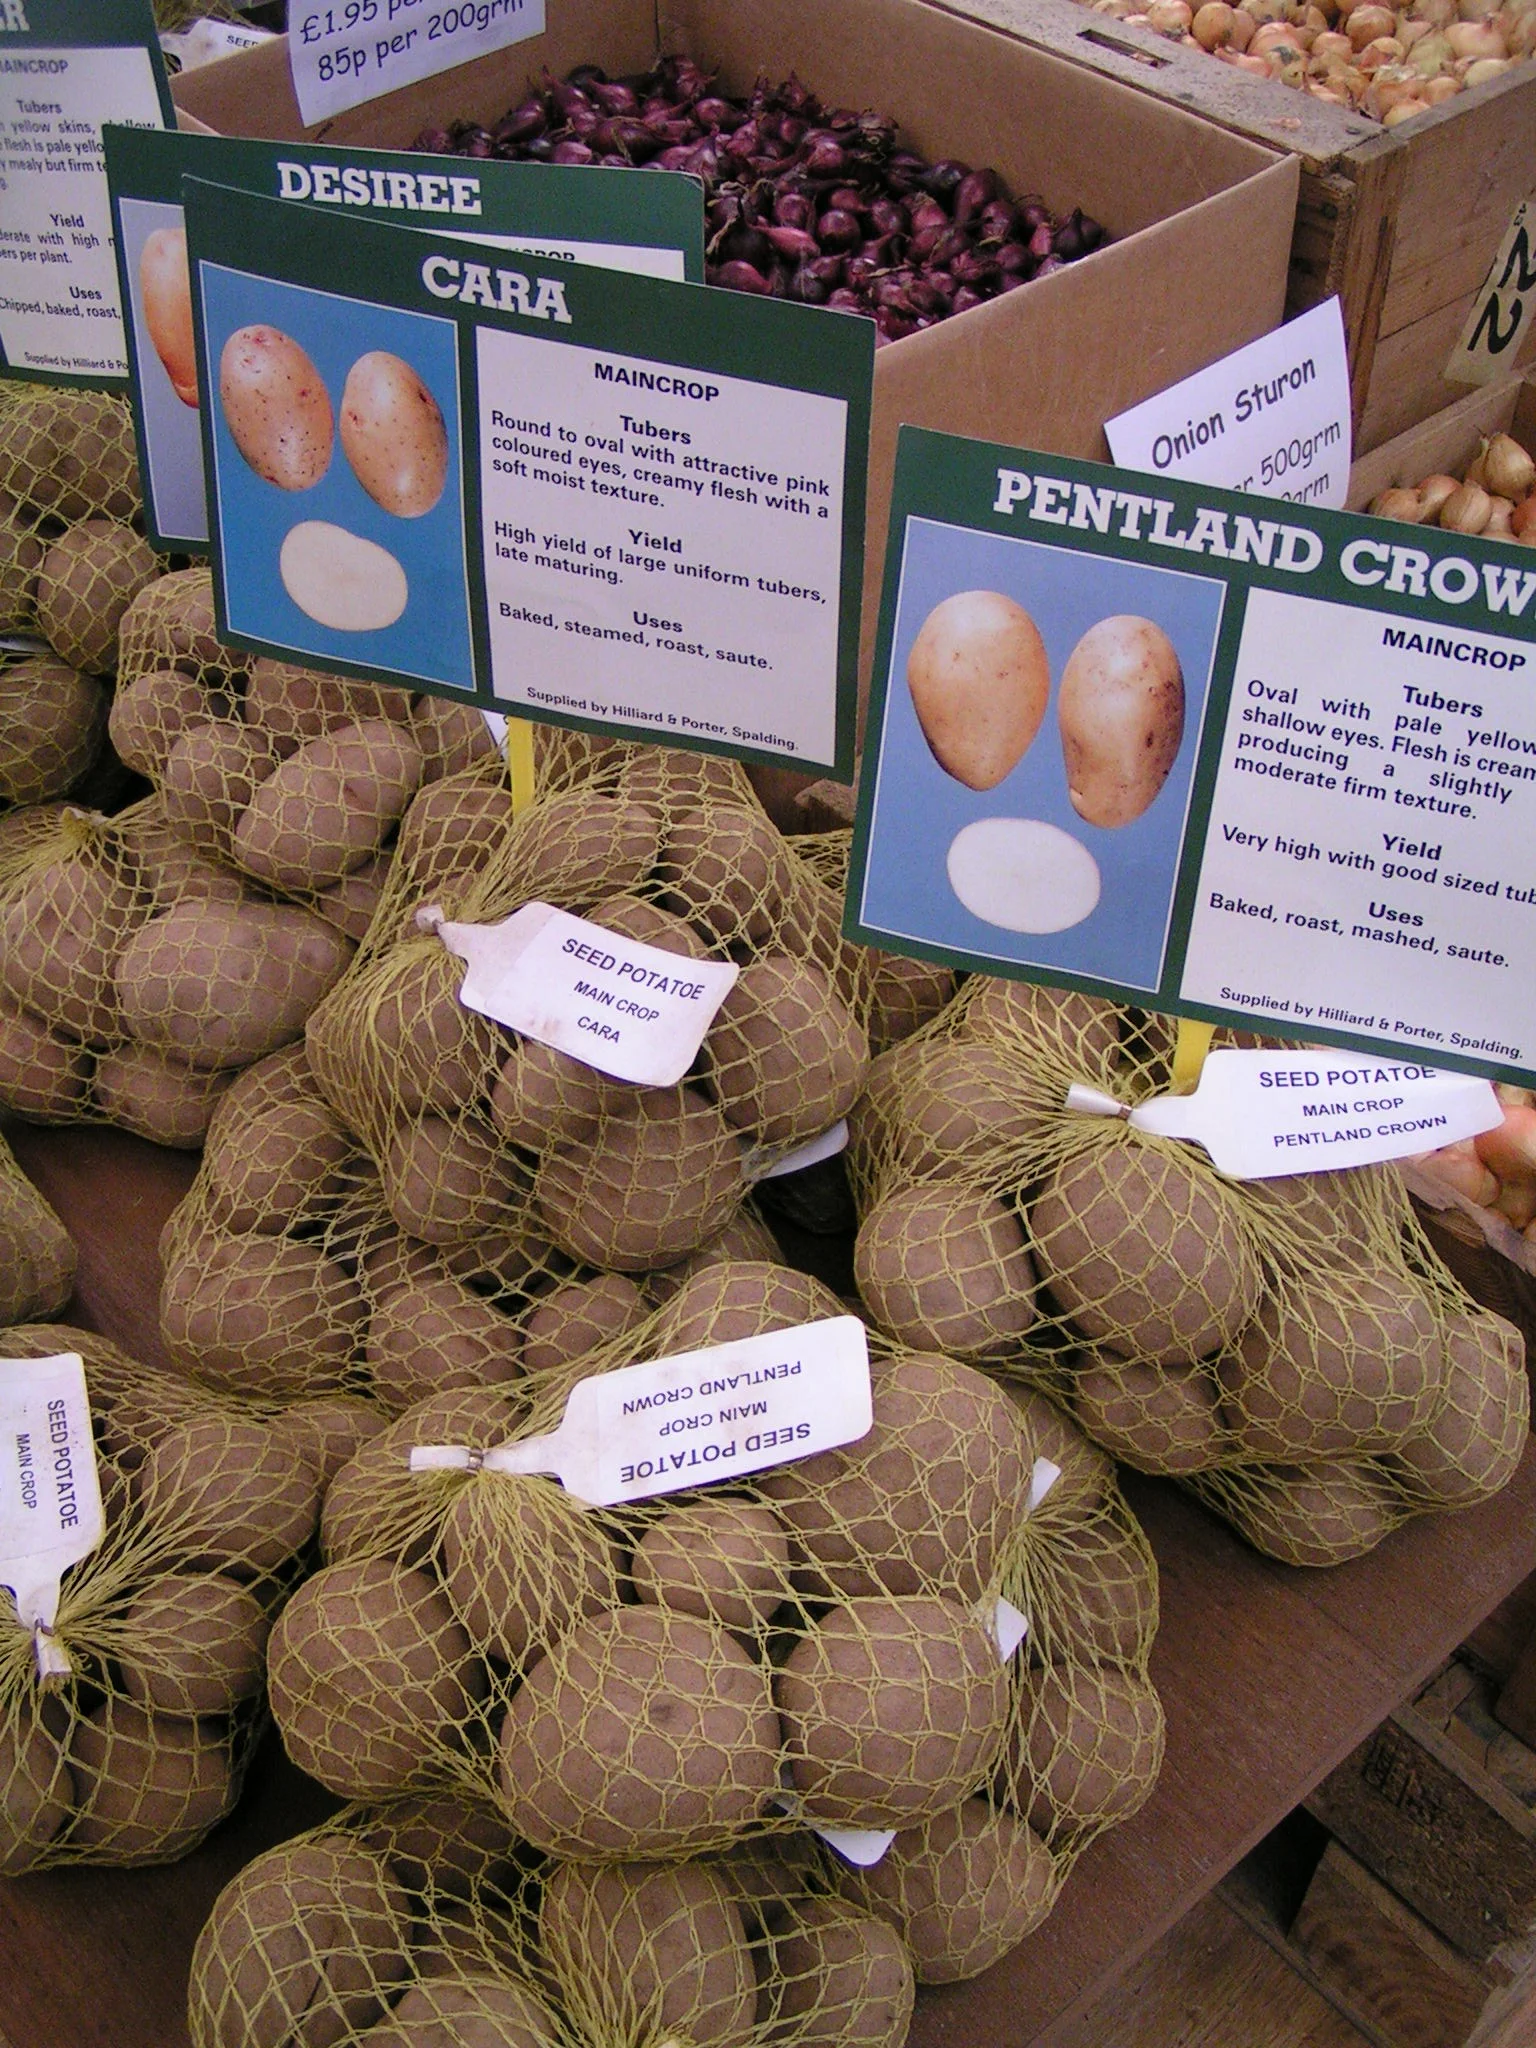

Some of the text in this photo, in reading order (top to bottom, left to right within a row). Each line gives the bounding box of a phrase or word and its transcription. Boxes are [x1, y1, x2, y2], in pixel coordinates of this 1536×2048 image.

[301, 0, 378, 43] £1.95
[318, 47, 367, 81] 85p
[377, 30, 417, 68] per
[428, 0, 524, 41] 200grm
[0, 59, 69, 74] AINCROP
[11, 119, 50, 135] yellow
[57, 120, 96, 135] skins,
[16, 99, 62, 114] Tubers
[9, 158, 43, 174] mealy
[45, 159, 66, 172] but
[68, 159, 95, 173] firm
[33, 137, 44, 153] is
[46, 139, 72, 155] pale
[74, 139, 105, 156] yello
[277, 162, 482, 216] DESIREE
[37, 231, 65, 246] with
[71, 233, 101, 249] high
[50, 214, 85, 228] Yield
[20, 250, 37, 263] per
[40, 249, 73, 264] plant.
[46, 301, 84, 318] baked,
[69, 286, 102, 300] Uses
[422, 255, 572, 324] CARA
[24, 351, 59, 366] Supplied
[60, 356, 71, 368] by
[73, 358, 106, 369] Hilliard
[594, 362, 720, 402] MAINCROP
[619, 414, 692, 445] Tubers
[1151, 358, 1316, 469] Onion Sturon
[491, 410, 831, 497] Round to oval with attractive pink
[1260, 421, 1341, 486] 500grm
[492, 436, 829, 519] coloured eyes, creamy flesh with a
[493, 457, 665, 508] soft moist texture.
[494, 521, 827, 604] High yield of large uniform tubers,
[628, 529, 683, 554] Yield
[992, 467, 1536, 617] PENTLAND CROW
[495, 543, 624, 585] late maturing.
[499, 602, 773, 671] Baked, steamed, roast, saute.
[633, 610, 683, 633] Uses
[1382, 627, 1526, 672] MAINCROP
[527, 686, 800, 751] Supplied by Hilliard & Porter, Spalding.
[1247, 679, 1536, 756] Oval with pale yellow
[1402, 685, 1484, 718] Tubers
[1242, 705, 1326, 736] shallow
[1331, 726, 1385, 750] eyes.
[1391, 735, 1448, 763] Flesh
[1454, 748, 1471, 767] is
[1233, 755, 1478, 820] moderate firm texture.
[1237, 731, 1513, 804] producing a slightly
[1222, 824, 1536, 906] Very high with good sized tub
[1382, 833, 1443, 861] Yield
[1209, 892, 1510, 967] Baked, roast, mashed, saute.
[1368, 901, 1425, 927] Uses
[562, 938, 706, 1001] SEED POTATOE
[573, 980, 661, 1023] MAIN CROP
[1220, 986, 1524, 1060] Supplied by Hilliard & Porter, Spalding.
[576, 1015, 622, 1044] CARA
[1259, 1065, 1437, 1089] SEED POTATOE
[1302, 1097, 1404, 1118] MAIN CROP
[1273, 1115, 1448, 1148] PENTLAND CROWN
[622, 1359, 802, 1416] PENTLAND CROWN
[659, 1400, 768, 1437] MAIN CROP
[16, 1433, 38, 1510] MAIN CROP
[47, 1399, 79, 1530] SEED POTATOE
[620, 1422, 812, 1484] SEED POTATOE
